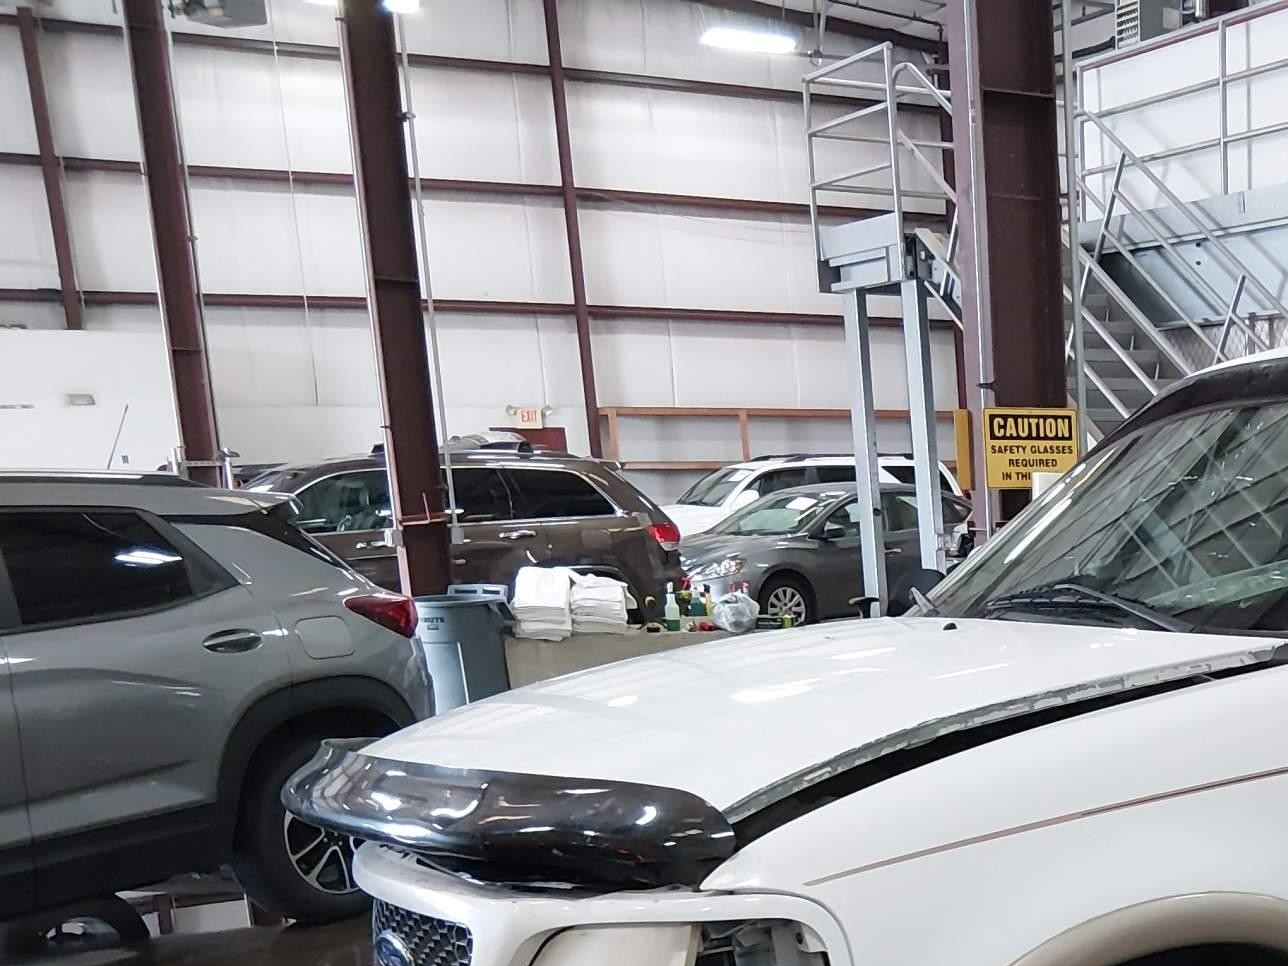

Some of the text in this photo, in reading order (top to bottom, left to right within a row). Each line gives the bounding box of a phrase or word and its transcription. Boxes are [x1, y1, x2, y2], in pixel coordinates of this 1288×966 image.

[521, 410, 537, 422] EXIT
[993, 417, 1069, 438] CAUTION
[991, 445, 1073, 455] SAFETY GLASSES
[1008, 458, 1058, 468] REQUIRED
[1002, 471, 1031, 481] IN THI
